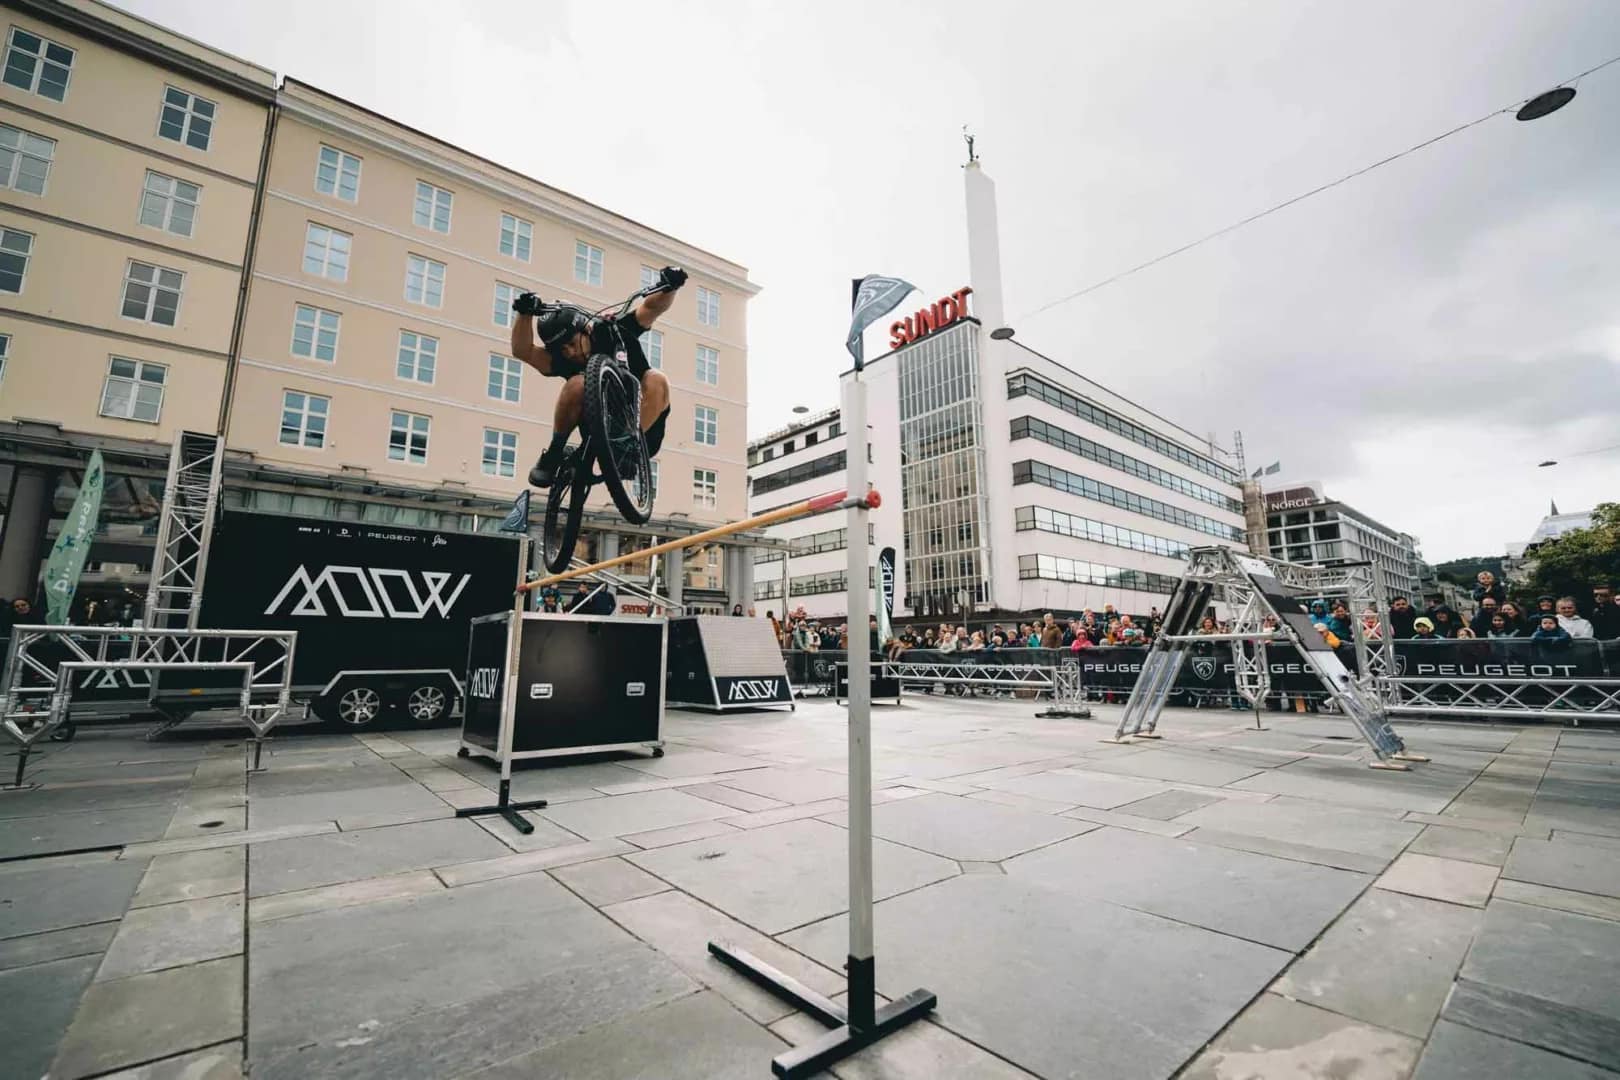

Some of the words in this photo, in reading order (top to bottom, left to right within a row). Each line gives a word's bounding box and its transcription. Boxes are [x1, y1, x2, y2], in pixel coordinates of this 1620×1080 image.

[890, 286, 973, 349] SUNDT
[1271, 497, 1313, 511] NORGE
[367, 532, 417, 542] PEUGEOT
[1084, 663, 1161, 673] PEUGE
[1223, 663, 1316, 674] PGEO
[1417, 663, 1577, 677] PEUGEOT
